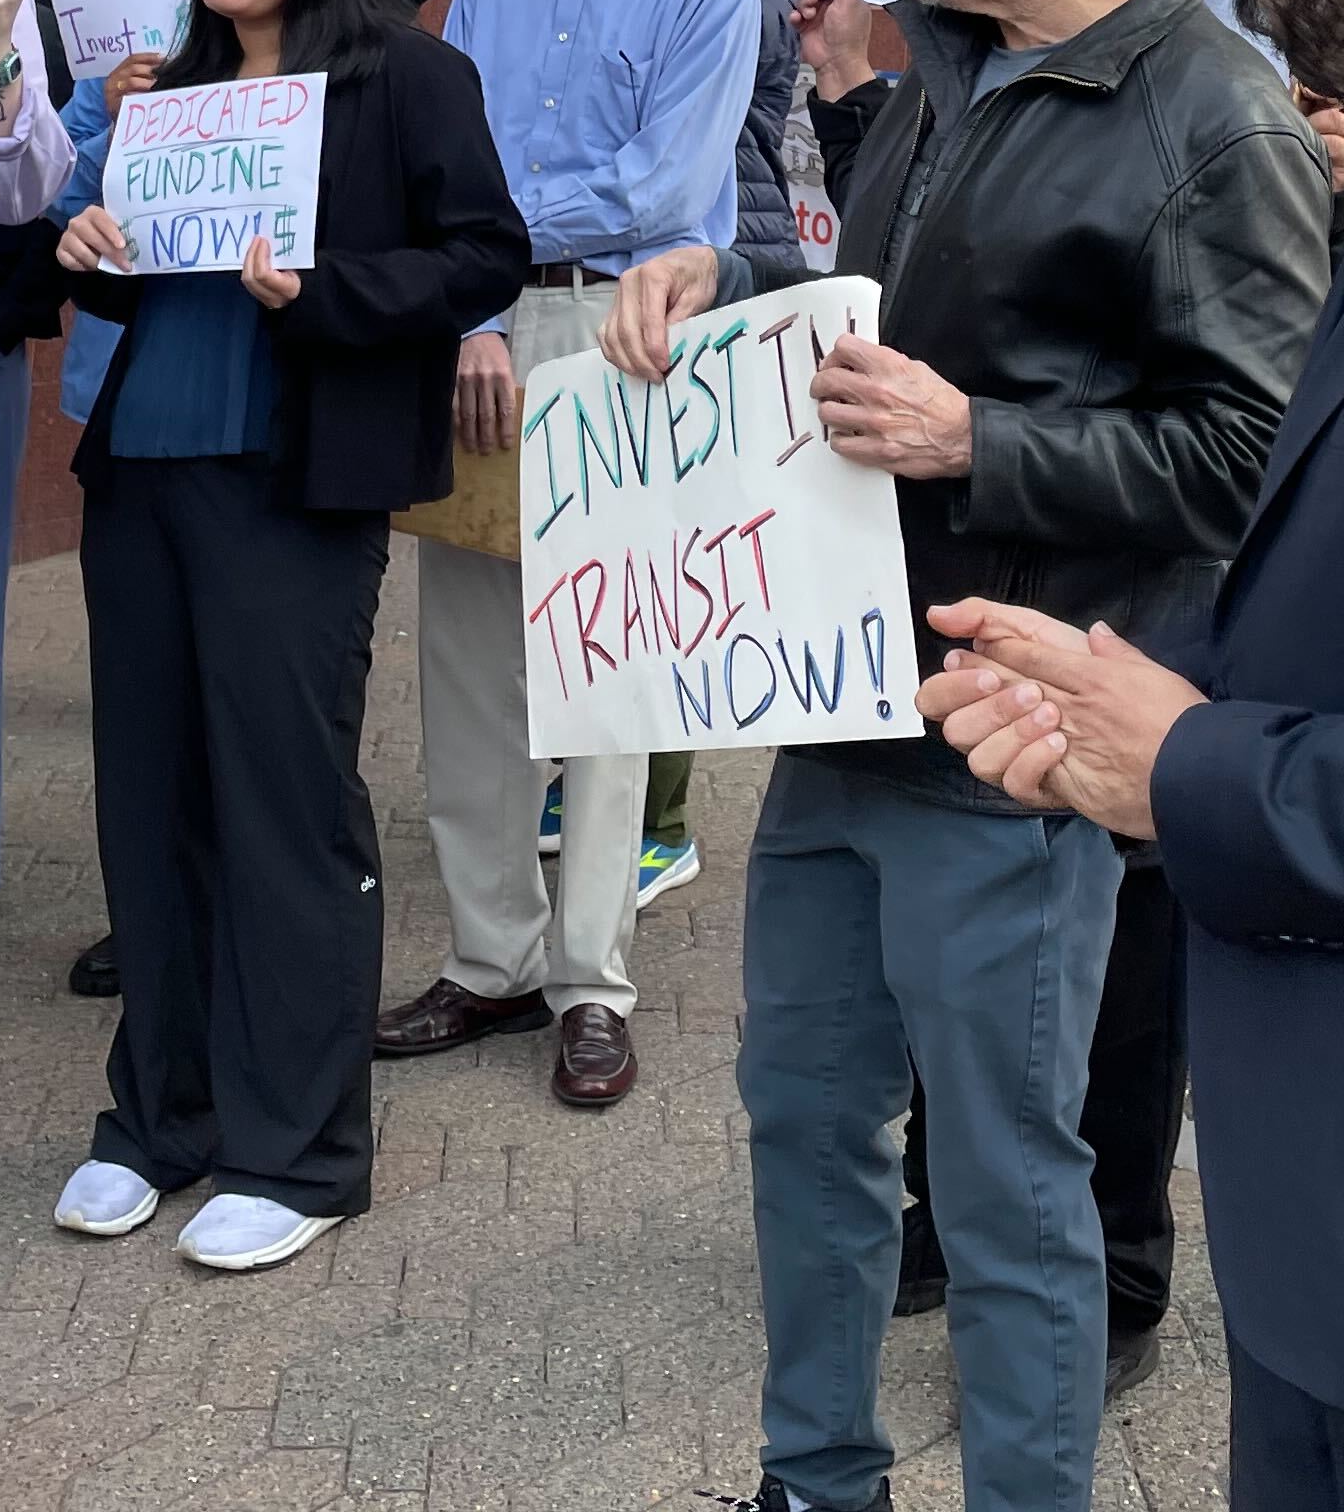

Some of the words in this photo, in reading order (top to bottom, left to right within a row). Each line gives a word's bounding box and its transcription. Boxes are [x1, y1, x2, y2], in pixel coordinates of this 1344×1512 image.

[59, 7, 136, 64] Invest
[142, 25, 164, 47] in
[122, 80, 309, 146] DEDICATED
[523, 318, 749, 541] INVEST
[529, 509, 777, 701] TRANSIT
[672, 607, 893, 737] NOW!
